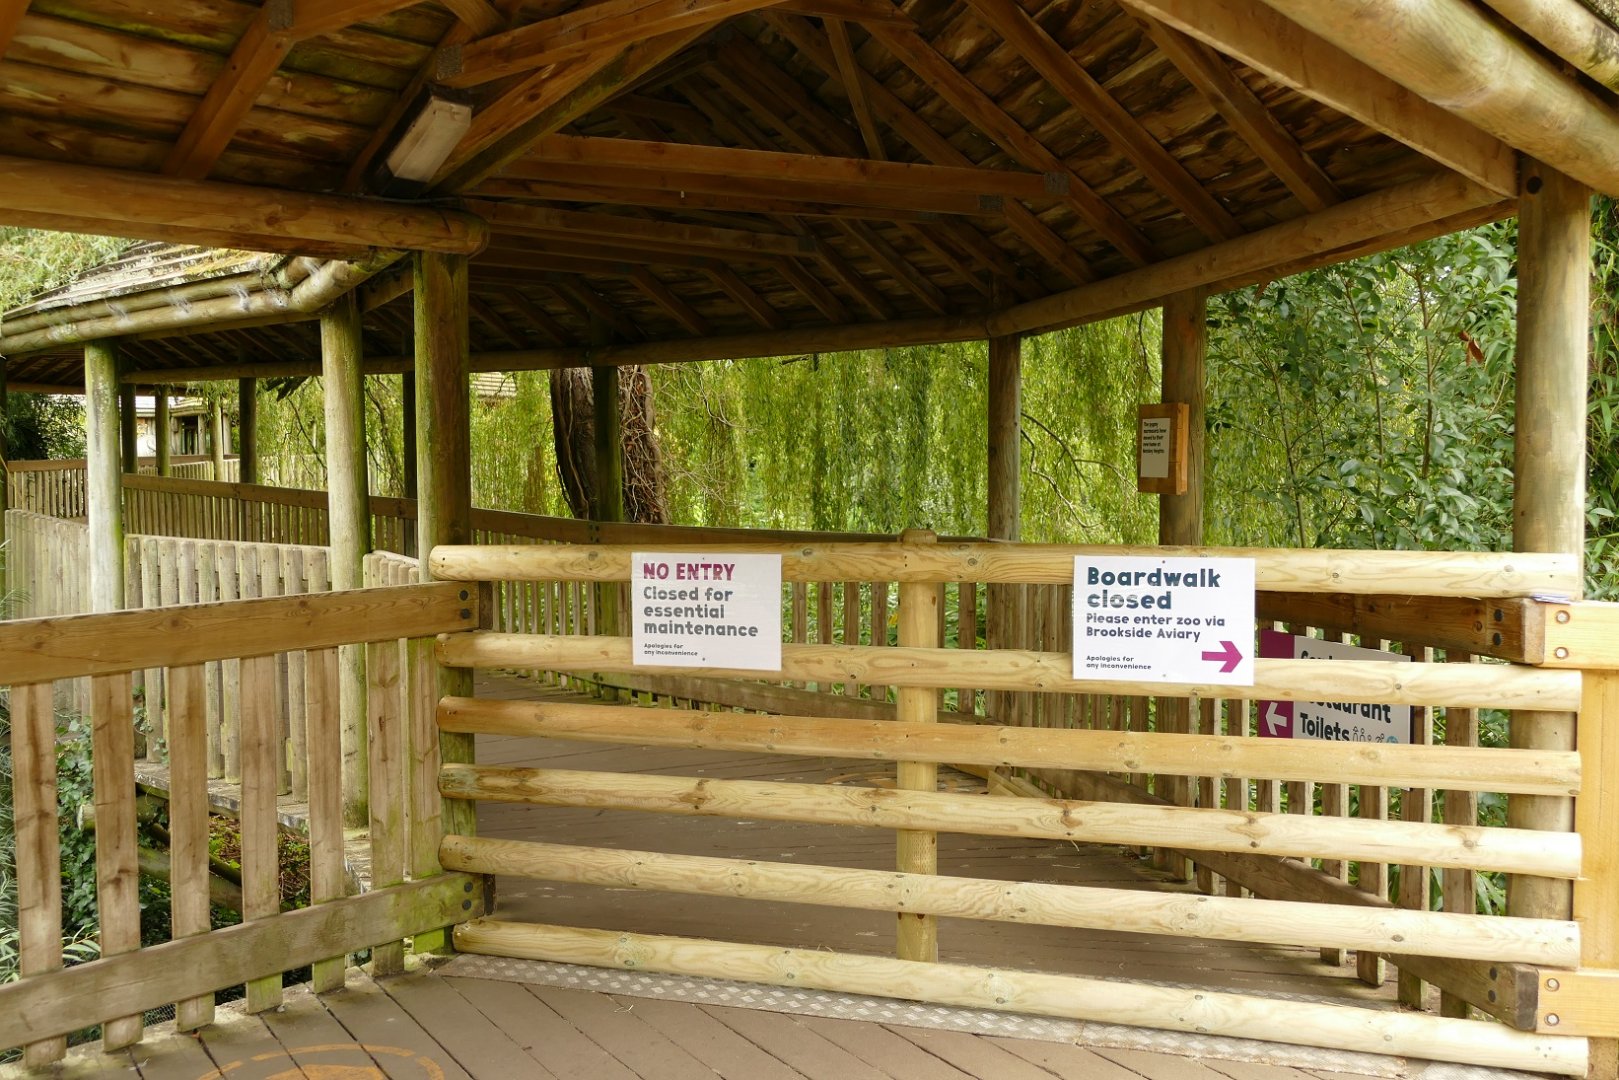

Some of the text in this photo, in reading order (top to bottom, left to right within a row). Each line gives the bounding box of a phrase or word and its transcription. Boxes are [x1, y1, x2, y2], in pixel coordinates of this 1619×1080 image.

[643, 562, 736, 581] NO ENTRY
[1087, 566, 1222, 588] Boardwalk
[643, 585, 734, 602] Closed for
[1087, 589, 1172, 610] closed
[643, 604, 725, 619] essential
[1086, 612, 1226, 627] Please enter zoo via
[644, 620, 759, 637] maintenance
[1086, 626, 1201, 643] Brookside Aviary
[1086, 655, 1121, 663] Apologies
[1100, 663, 1152, 671] inconvenience
[1299, 712, 1350, 742] Toilets
